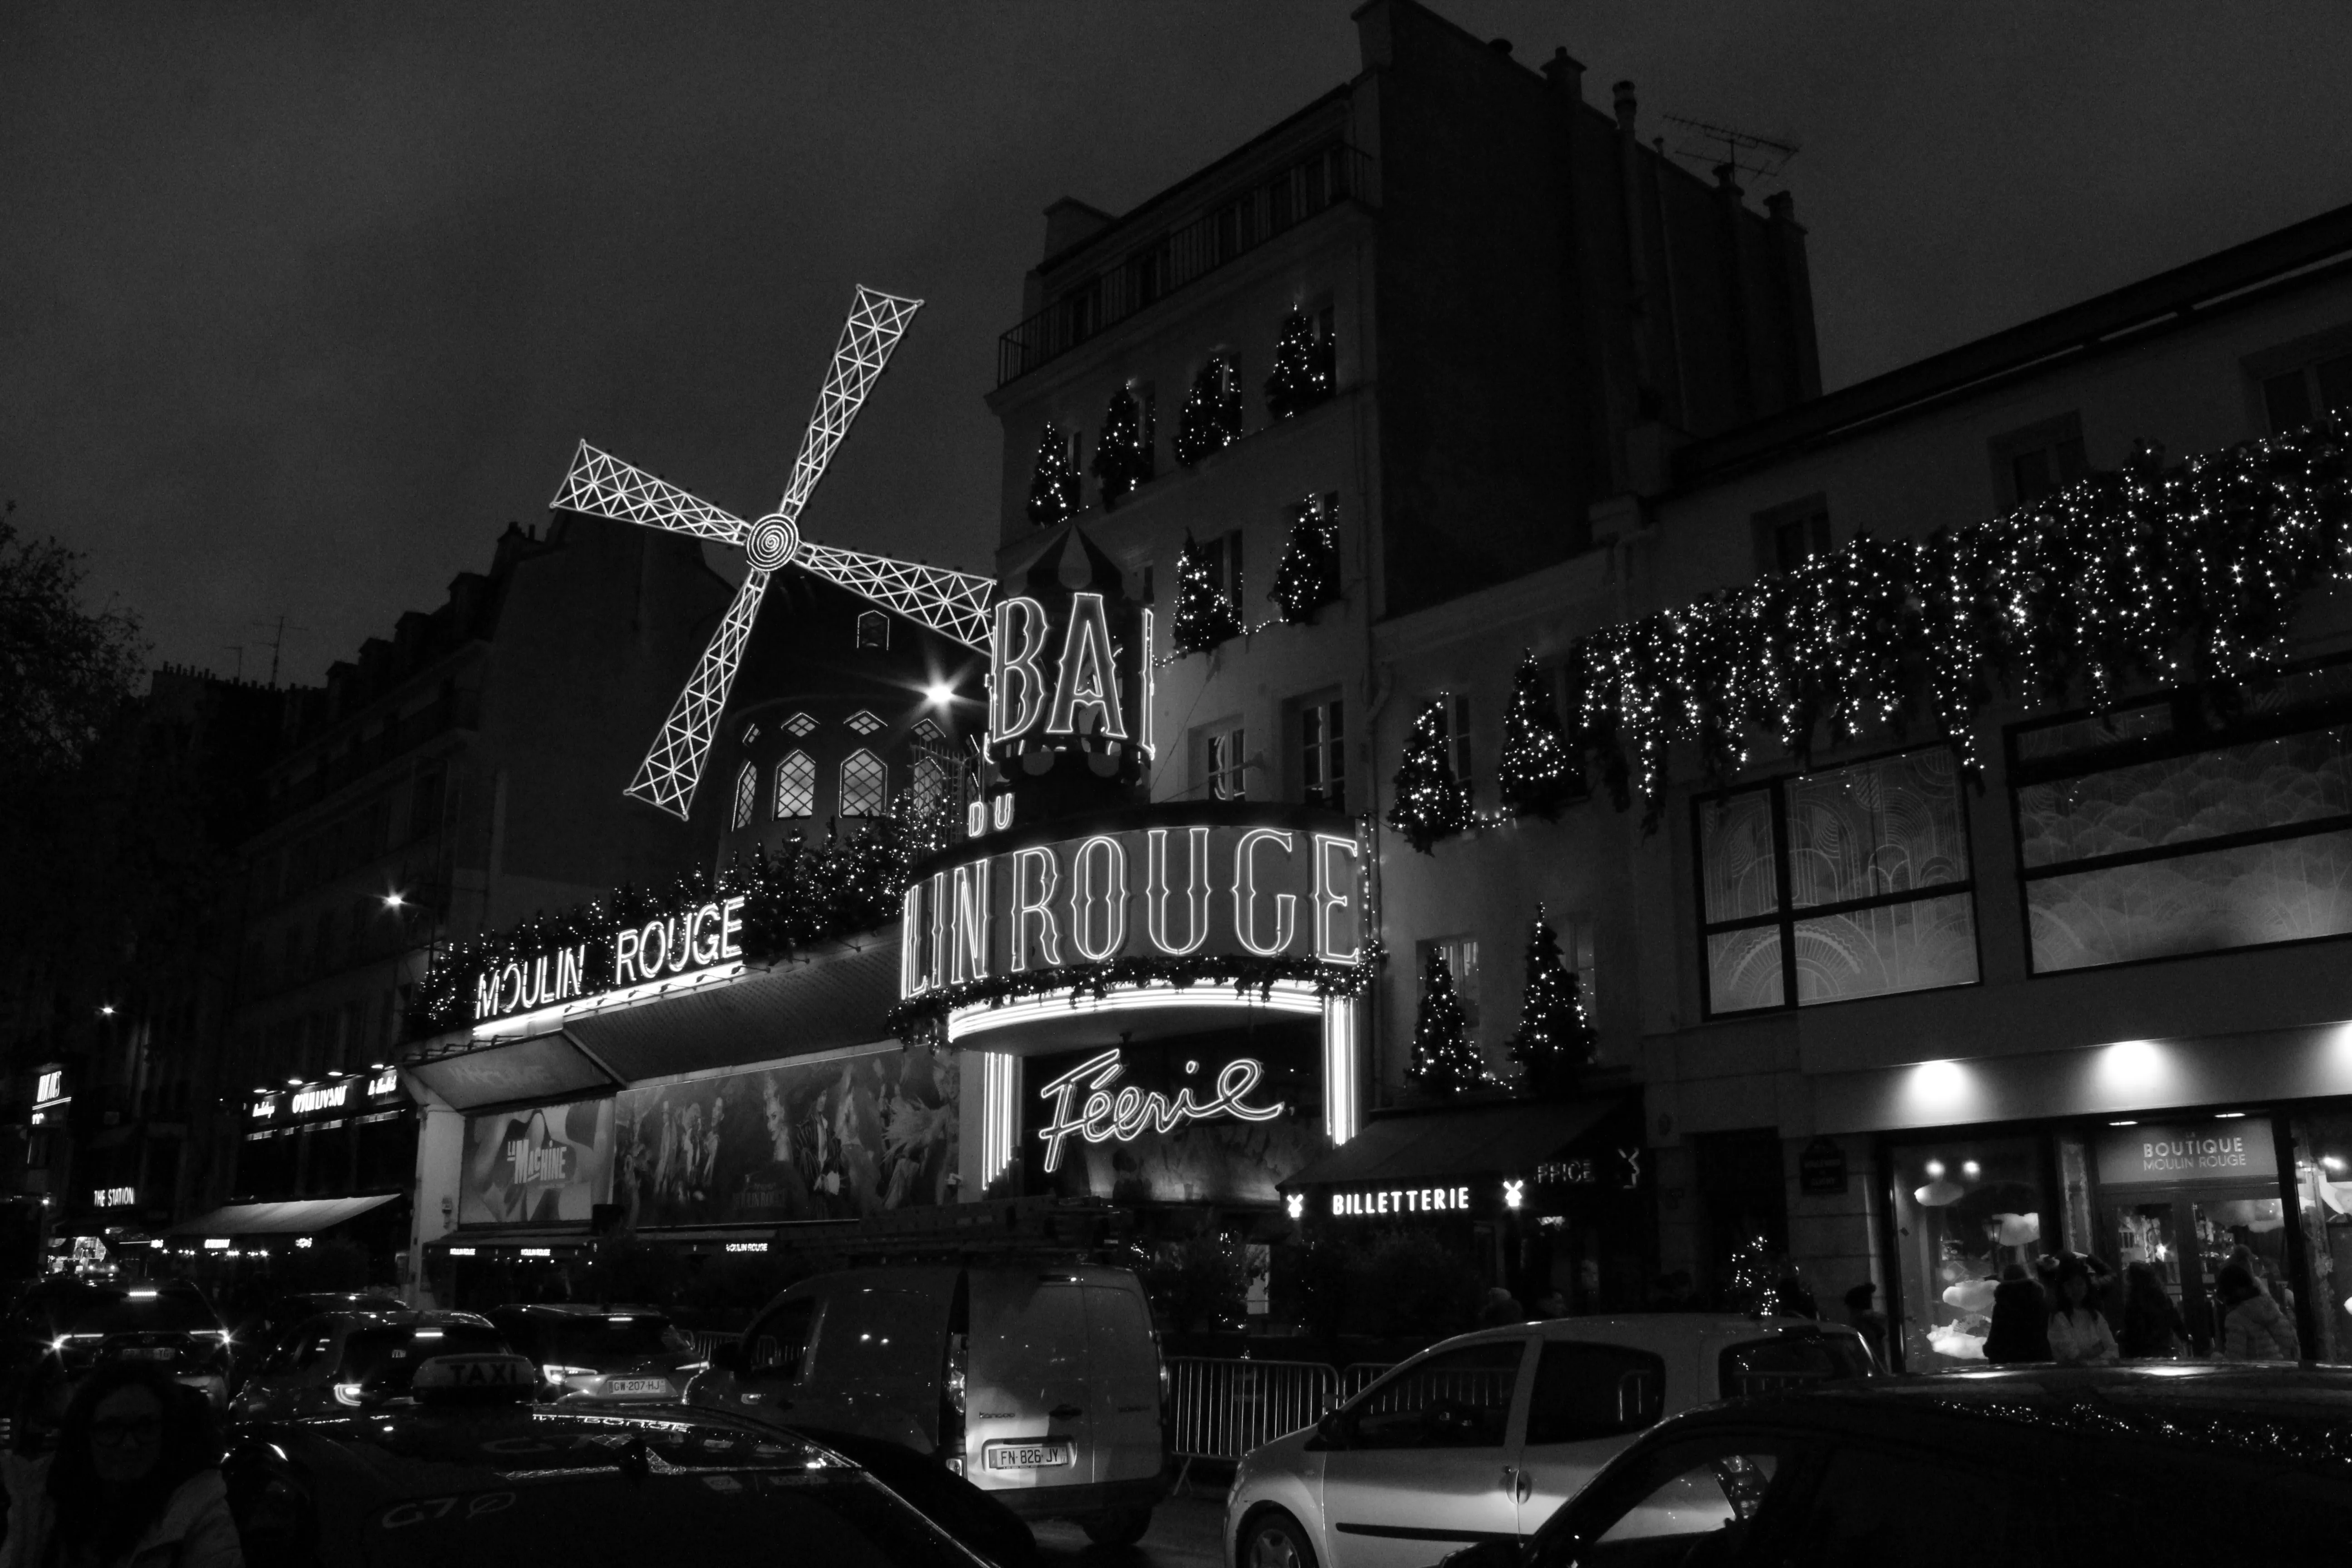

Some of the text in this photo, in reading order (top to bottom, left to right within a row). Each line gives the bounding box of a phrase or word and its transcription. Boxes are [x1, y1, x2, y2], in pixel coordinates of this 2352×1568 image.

[967, 793, 1014, 838] DU
[1011, 827, 1360, 972] ROUGE
[474, 895, 745, 1019] MOULIN ROUGE
[1039, 1048, 1285, 1173] Féerie
[2143, 1137, 2244, 1158] BOUTIQUE
[2143, 1153, 2247, 1171] MOULIN ROUGE
[1534, 1159, 1595, 1184] FFICE
[94, 1187, 135, 1207] THE STATION
[1332, 1186, 1470, 1215] BILLETTERIE
